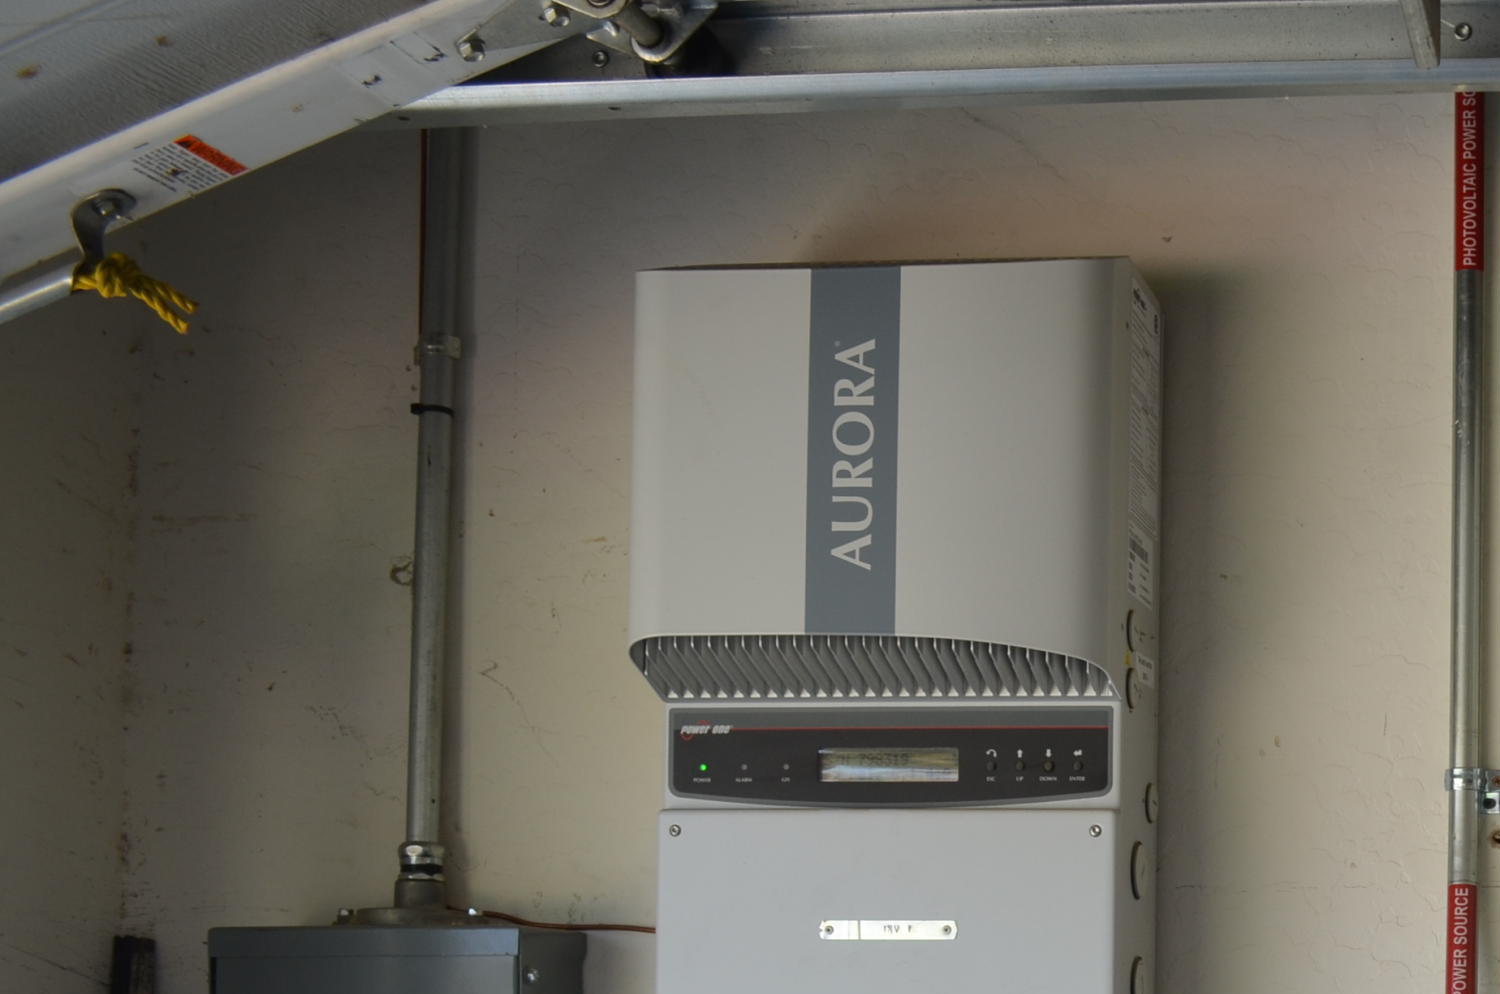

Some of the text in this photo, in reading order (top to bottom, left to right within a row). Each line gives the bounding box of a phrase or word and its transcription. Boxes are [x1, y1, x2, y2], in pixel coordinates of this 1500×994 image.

[1463, 111, 1476, 159] POWER
[1463, 163, 1476, 265] PHOTOVOLTAIC
[831, 339, 876, 571] AURORA
[1454, 888, 1468, 944] SOURCE
